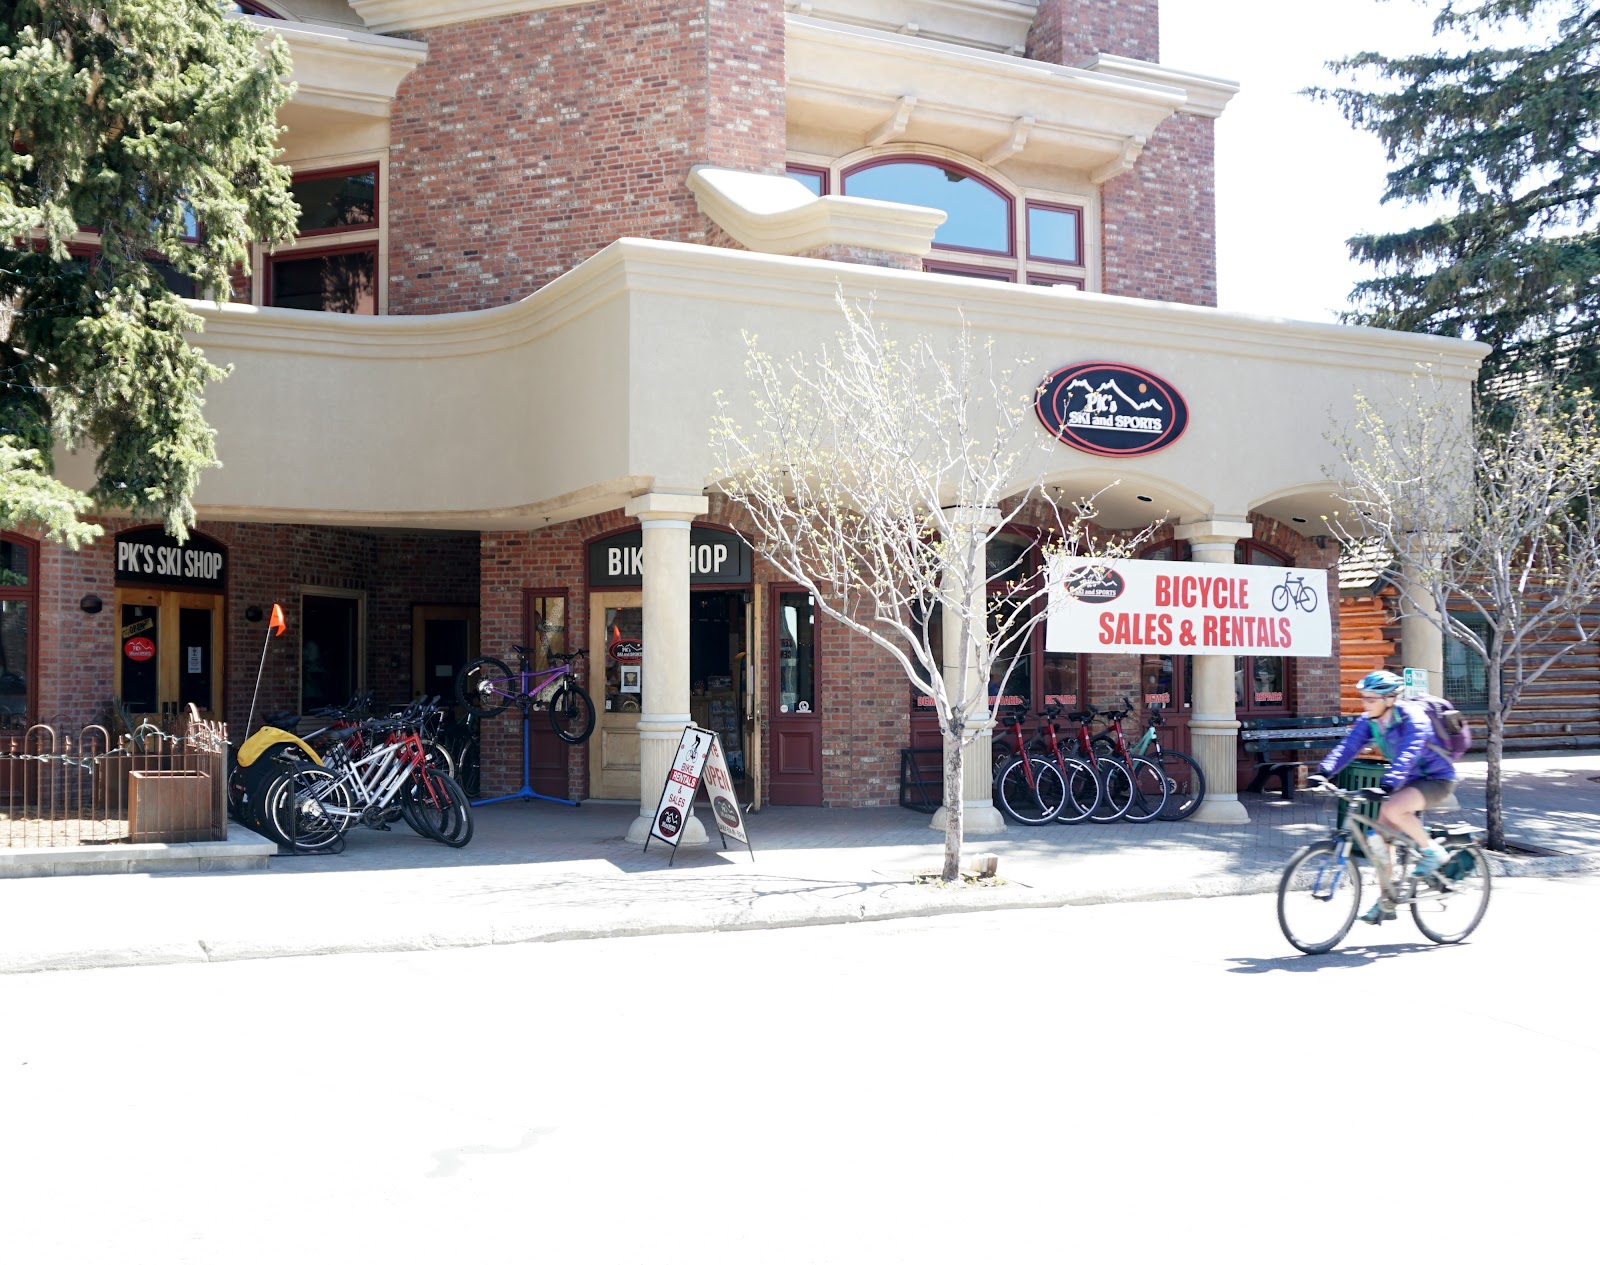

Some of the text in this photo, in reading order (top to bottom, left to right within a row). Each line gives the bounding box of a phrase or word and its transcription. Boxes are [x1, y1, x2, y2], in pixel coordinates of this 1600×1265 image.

[1069, 411, 1162, 430] SKI and SPORTS
[118, 541, 223, 580] PK'S SKI SHOP
[608, 544, 728, 576] BIK OP
[1155, 574, 1249, 610] BICYCLE
[1098, 611, 1292, 649] SALES & RENTALS
[672, 771, 696, 787] RENTALS
[681, 763, 695, 774] BIKE
[704, 765, 731, 792] OPEN
[669, 794, 685, 807] SALES
